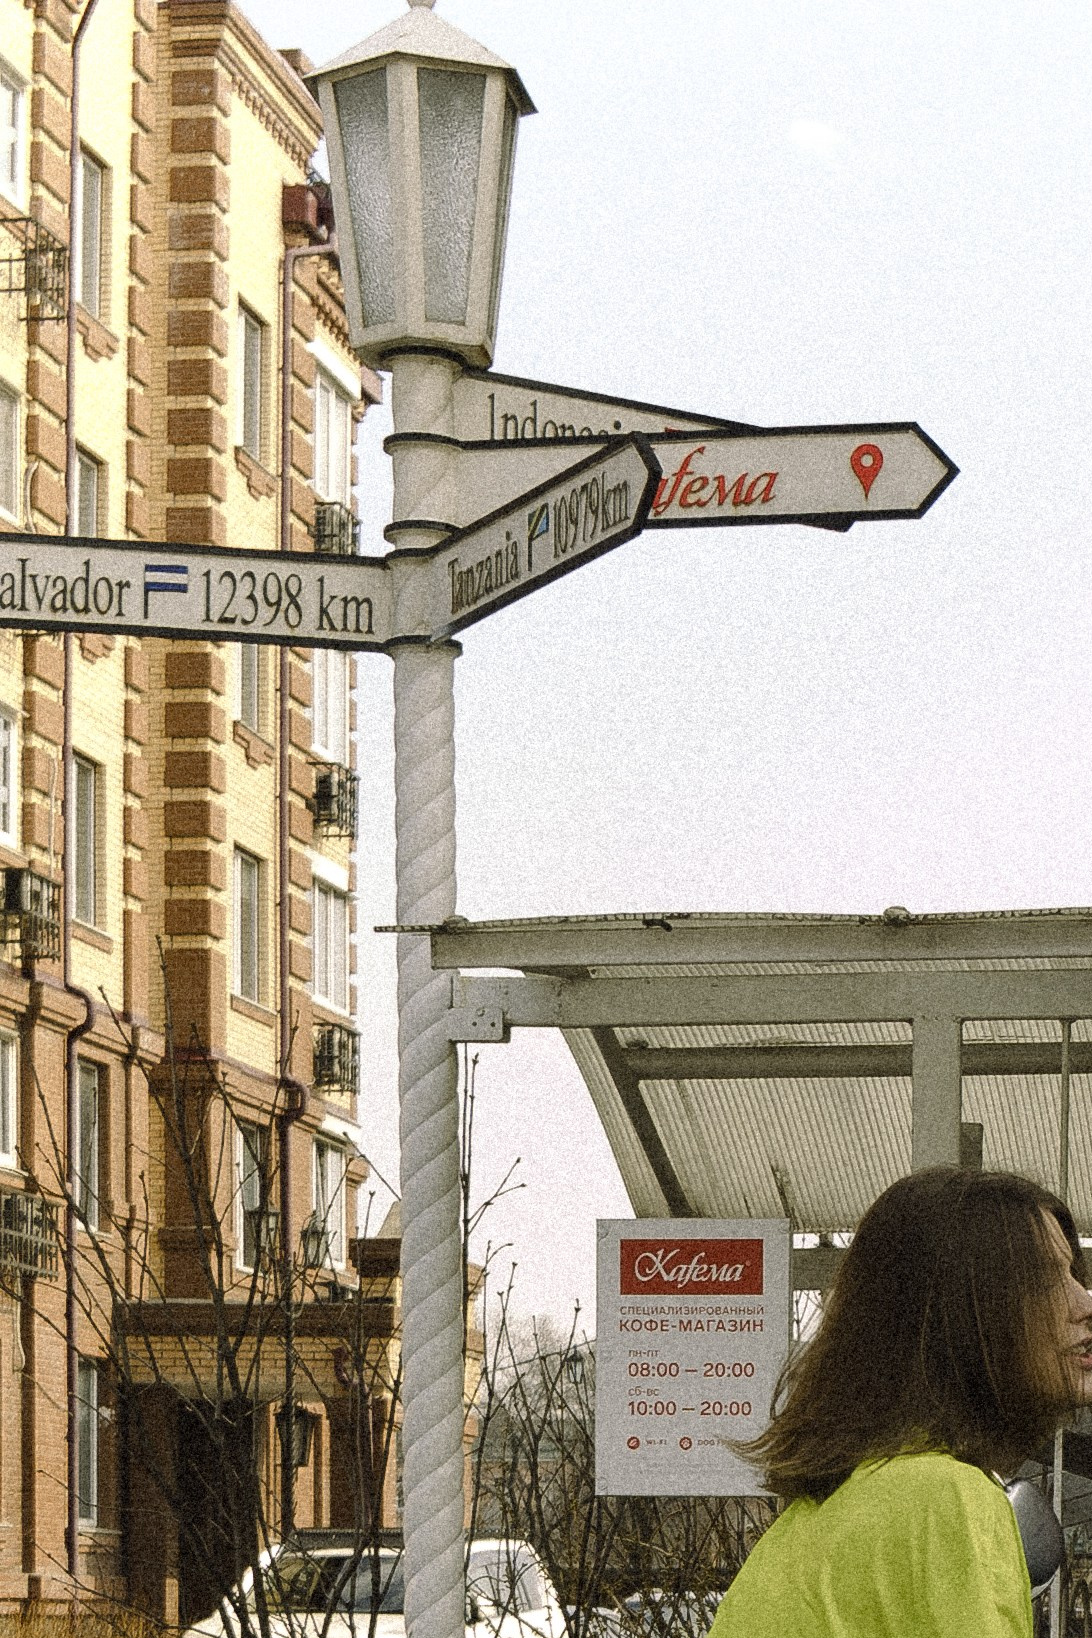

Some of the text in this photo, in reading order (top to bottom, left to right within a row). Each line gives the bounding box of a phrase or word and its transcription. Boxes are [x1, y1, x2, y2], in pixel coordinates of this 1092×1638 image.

[448, 472, 631, 615] Tanzania 10979 km
[0, 558, 375, 635] alvador 12398 km
[619, 1304, 764, 1316] СПЕЦИАЛИЗИРОВАННЫЙ
[619, 1319, 764, 1332] КОФЕ-МАГАЗИН
[628, 1362, 680, 1378] 08:00
[703, 1362, 755, 1378] 20:00
[628, 1401, 677, 1416] 10:00
[700, 1401, 752, 1416] 20:00
